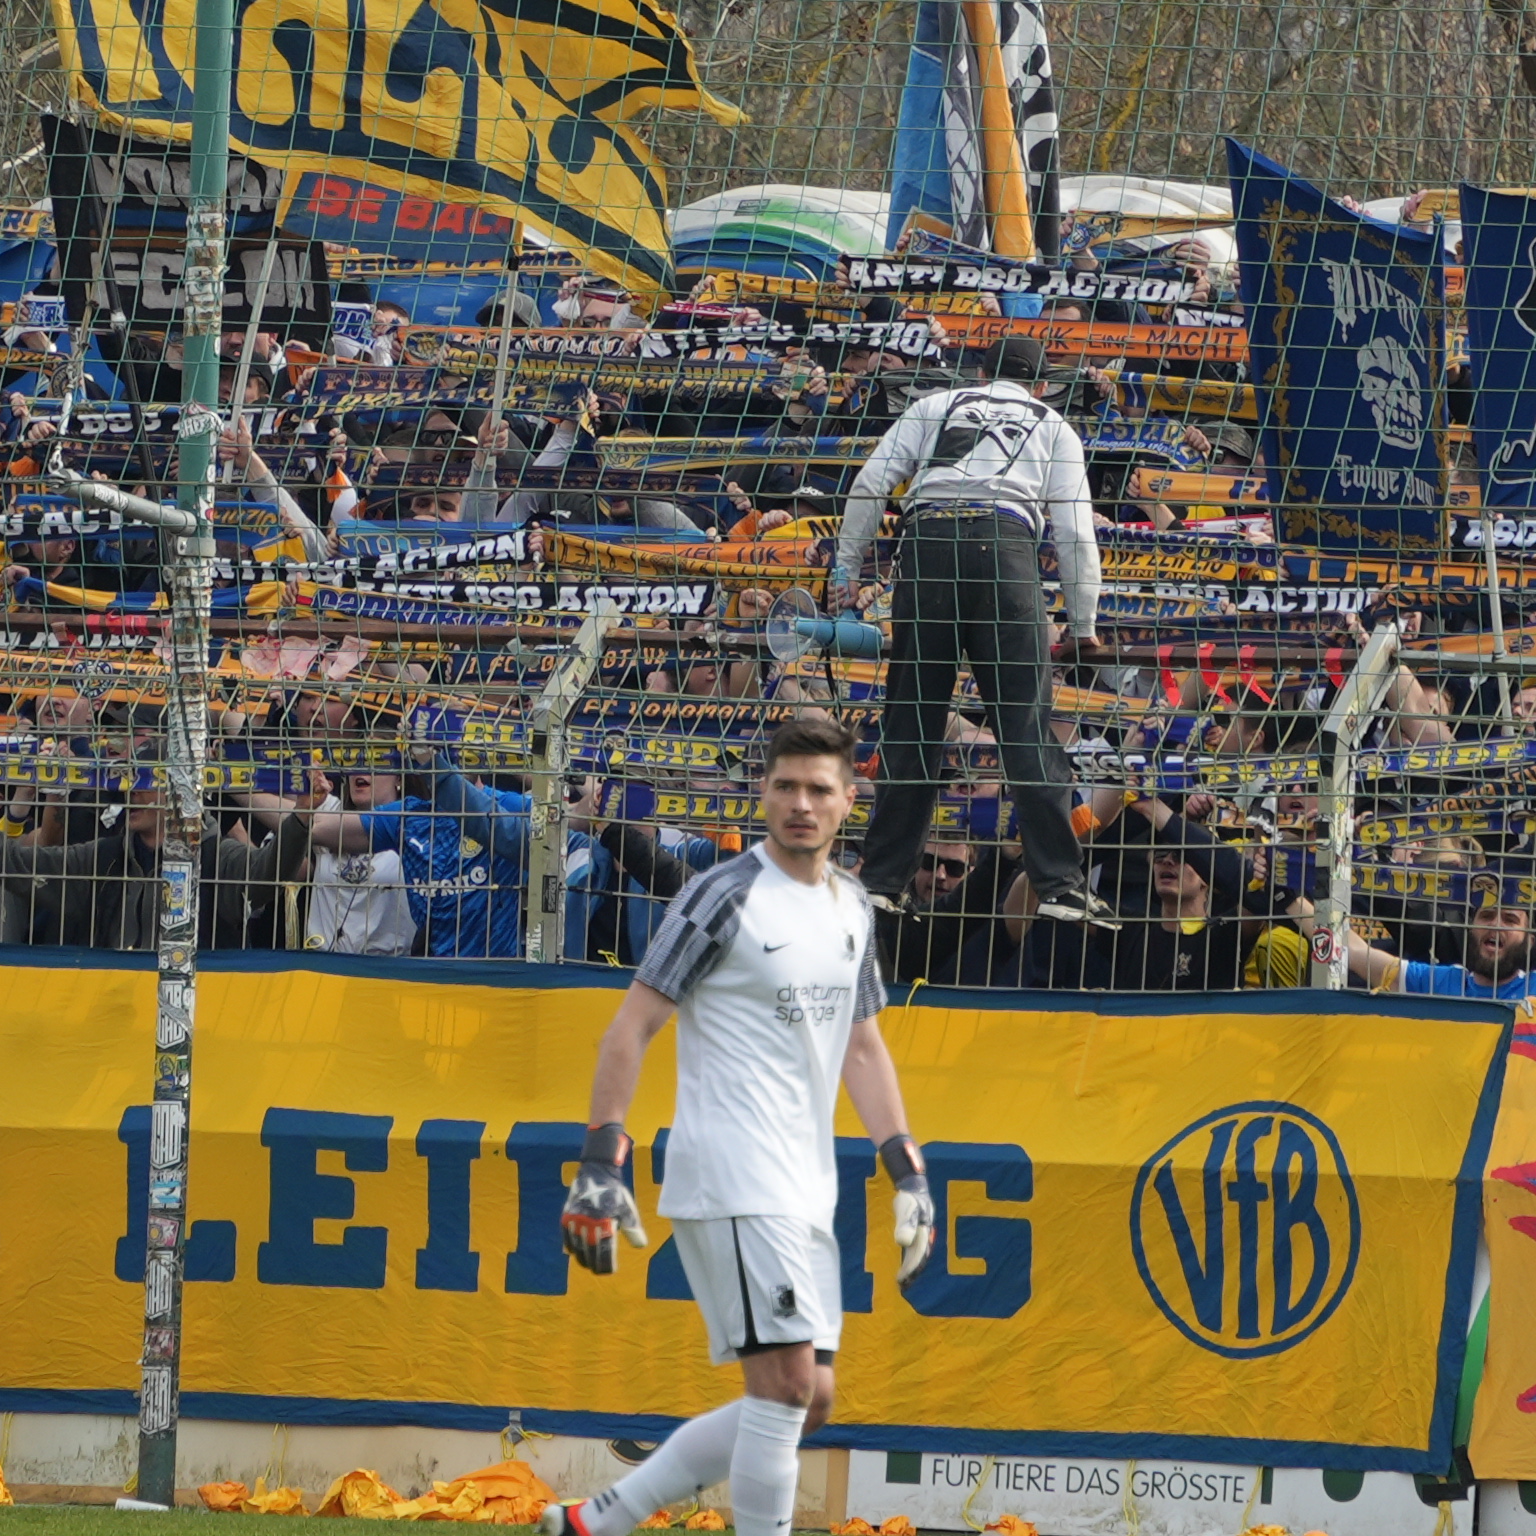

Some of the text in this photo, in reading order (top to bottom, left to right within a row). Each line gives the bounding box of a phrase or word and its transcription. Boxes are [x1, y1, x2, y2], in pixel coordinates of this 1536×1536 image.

[306, 175, 382, 226] BE
[850, 260, 1195, 304] ANTI BSG ACTION
[1087, 332, 1136, 353] EINE
[1146, 326, 1240, 360] MACHT
[210, 557, 280, 581] NTI
[373, 533, 526, 578] ACTION
[464, 583, 542, 611] BSG
[549, 584, 709, 614] ACTION
[1238, 585, 1381, 614] ACTIO
[1404, 741, 1528, 771] SIDE
[150, 765, 255, 792] SDE
[1359, 806, 1493, 847] BLUE
[1352, 865, 1453, 900] LUE
[1150, 1112, 1334, 1344] VfB
[931, 1454, 1252, 1505] FÜR TIERE DAS GRÖSSTE.
